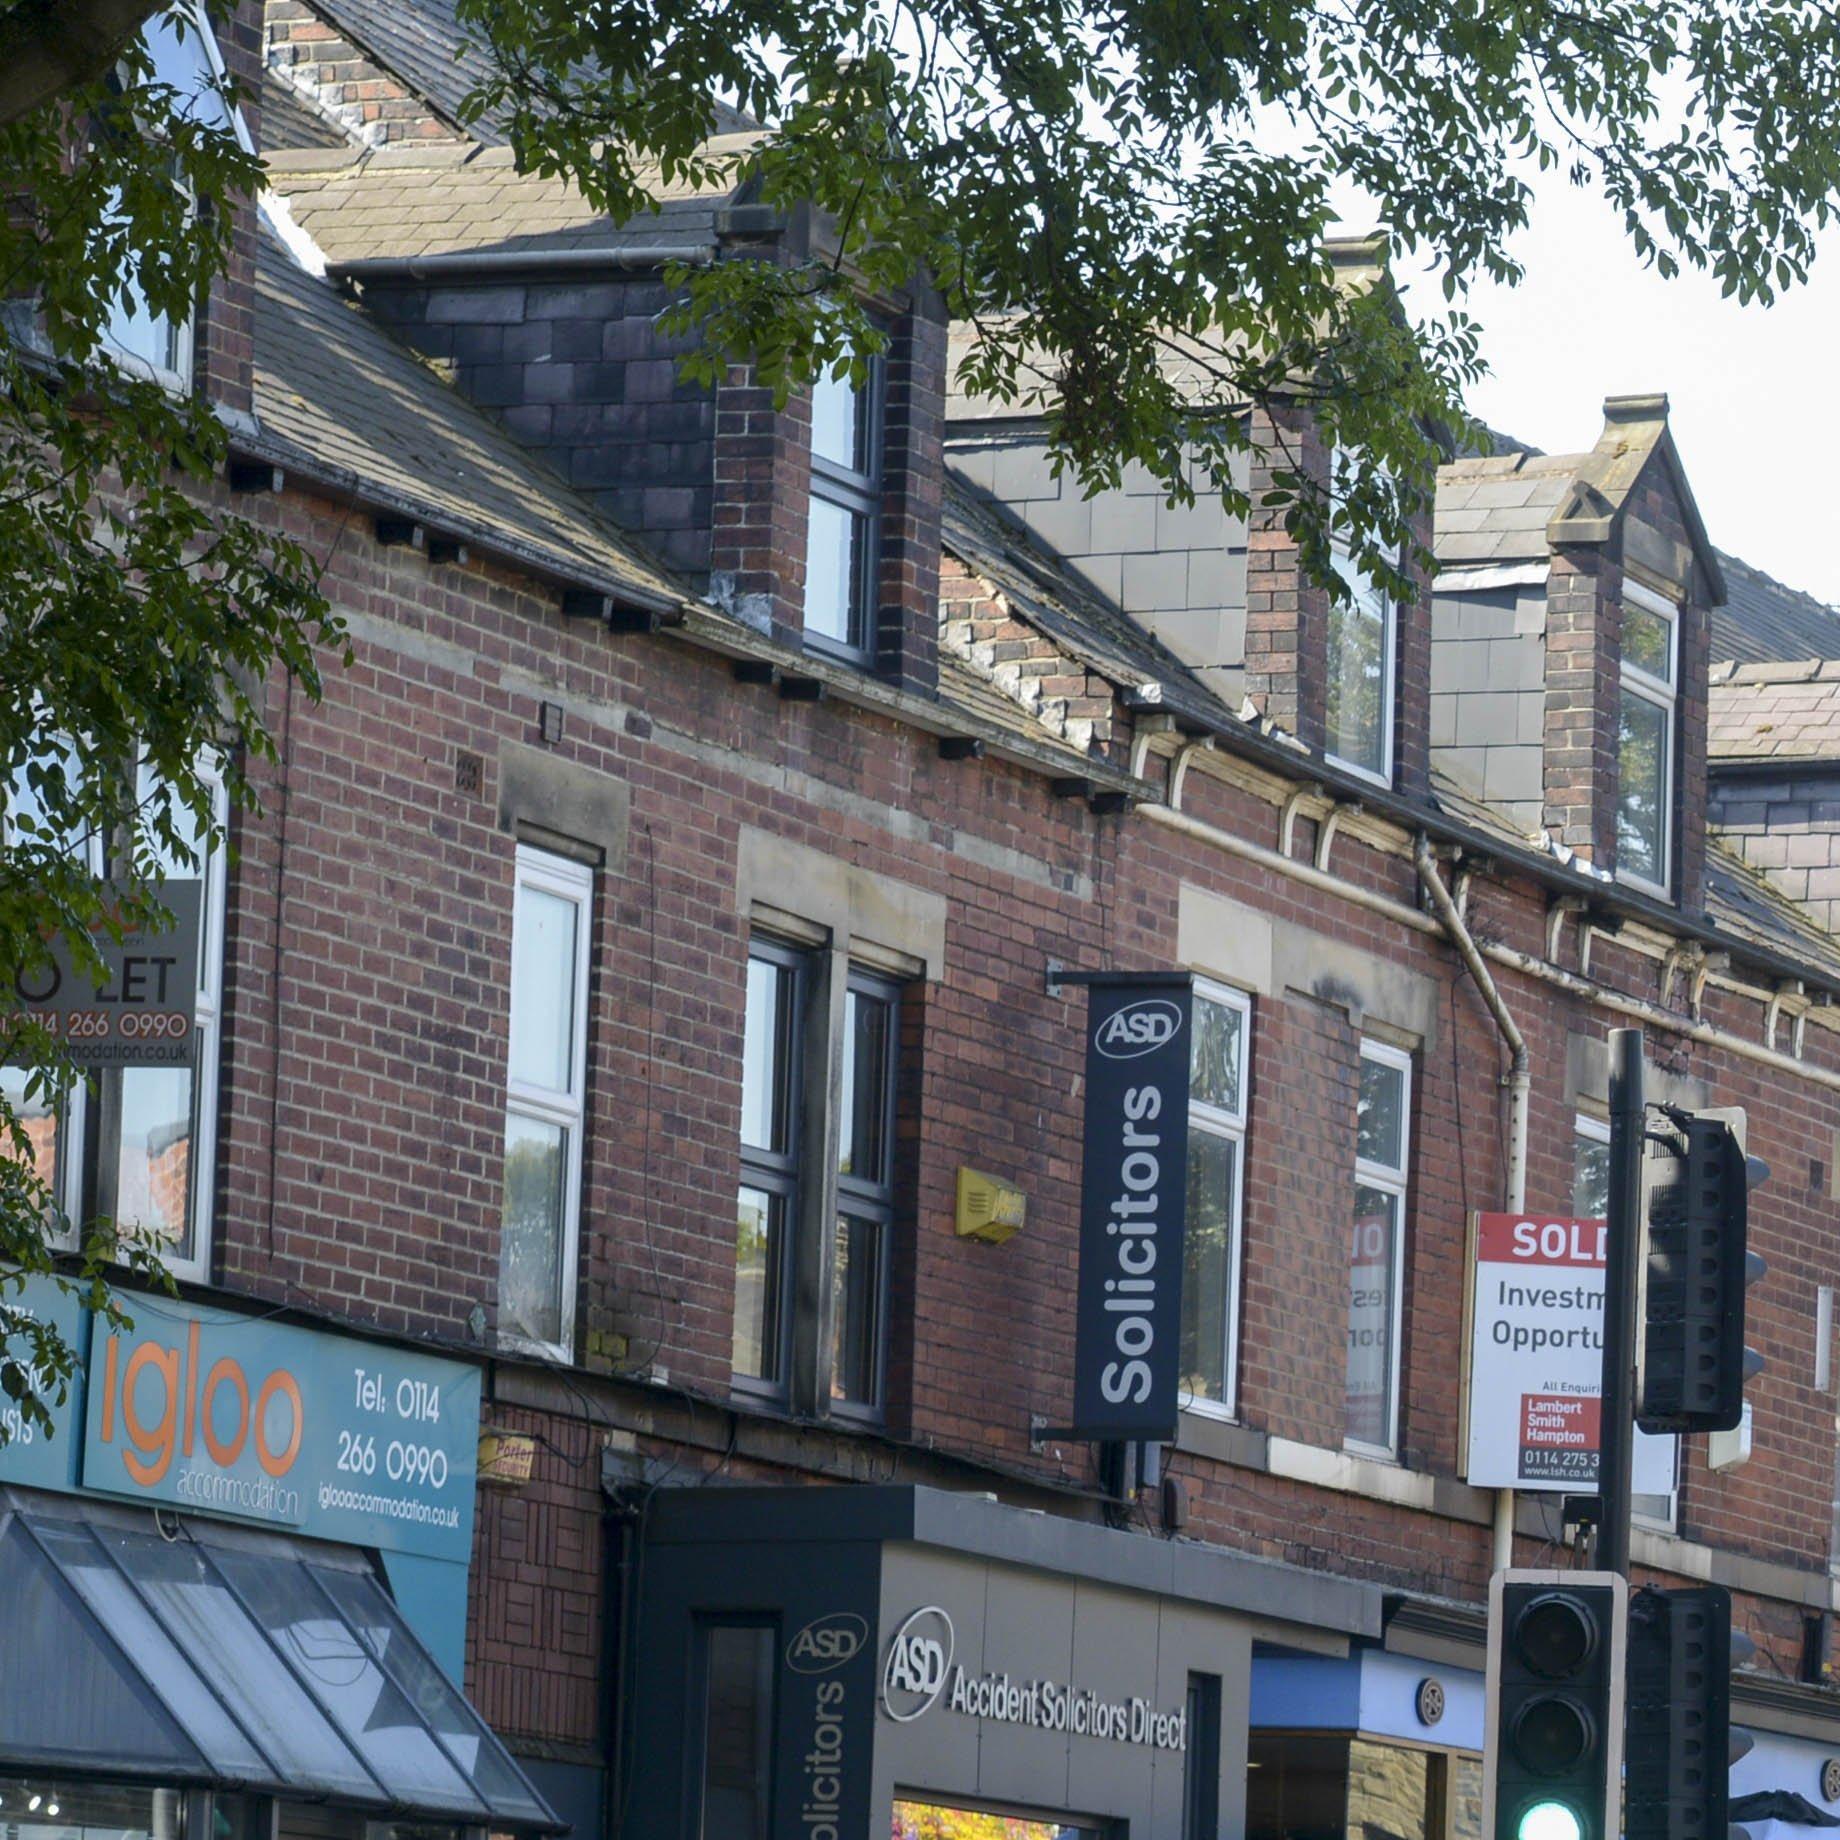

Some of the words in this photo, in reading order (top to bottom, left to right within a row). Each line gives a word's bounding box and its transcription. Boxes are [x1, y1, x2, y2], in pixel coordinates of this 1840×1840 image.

[69, 1012, 109, 1038] 266
[119, 1013, 187, 1039] 0990
[1106, 1012, 1173, 1043] ASD
[1101, 1085, 1163, 1404] Solicitors
[101, 1303, 304, 1487] igloo
[396, 1379, 441, 1424] 0114
[1543, 1381, 1558, 1392] All
[1561, 1382, 1600, 1396] Enquiri
[1527, 1413, 1565, 1428] Smith
[1528, 1399, 1582, 1415] Lambert
[1526, 1428, 1585, 1445] Hampton
[338, 1431, 375, 1475] 266
[386, 1443, 448, 1489] 0990
[1525, 1451, 1558, 1465] 0114
[1562, 1453, 1588, 1467] 275
[177, 1469, 299, 1516] accommodation
[794, 1628, 857, 1660] ASD
[890, 1635, 943, 1694] ASD
[951, 1665, 1038, 1725] Accident
[1041, 1681, 1127, 1740] Solicitors
[1131, 1697, 1187, 1751] Direct
